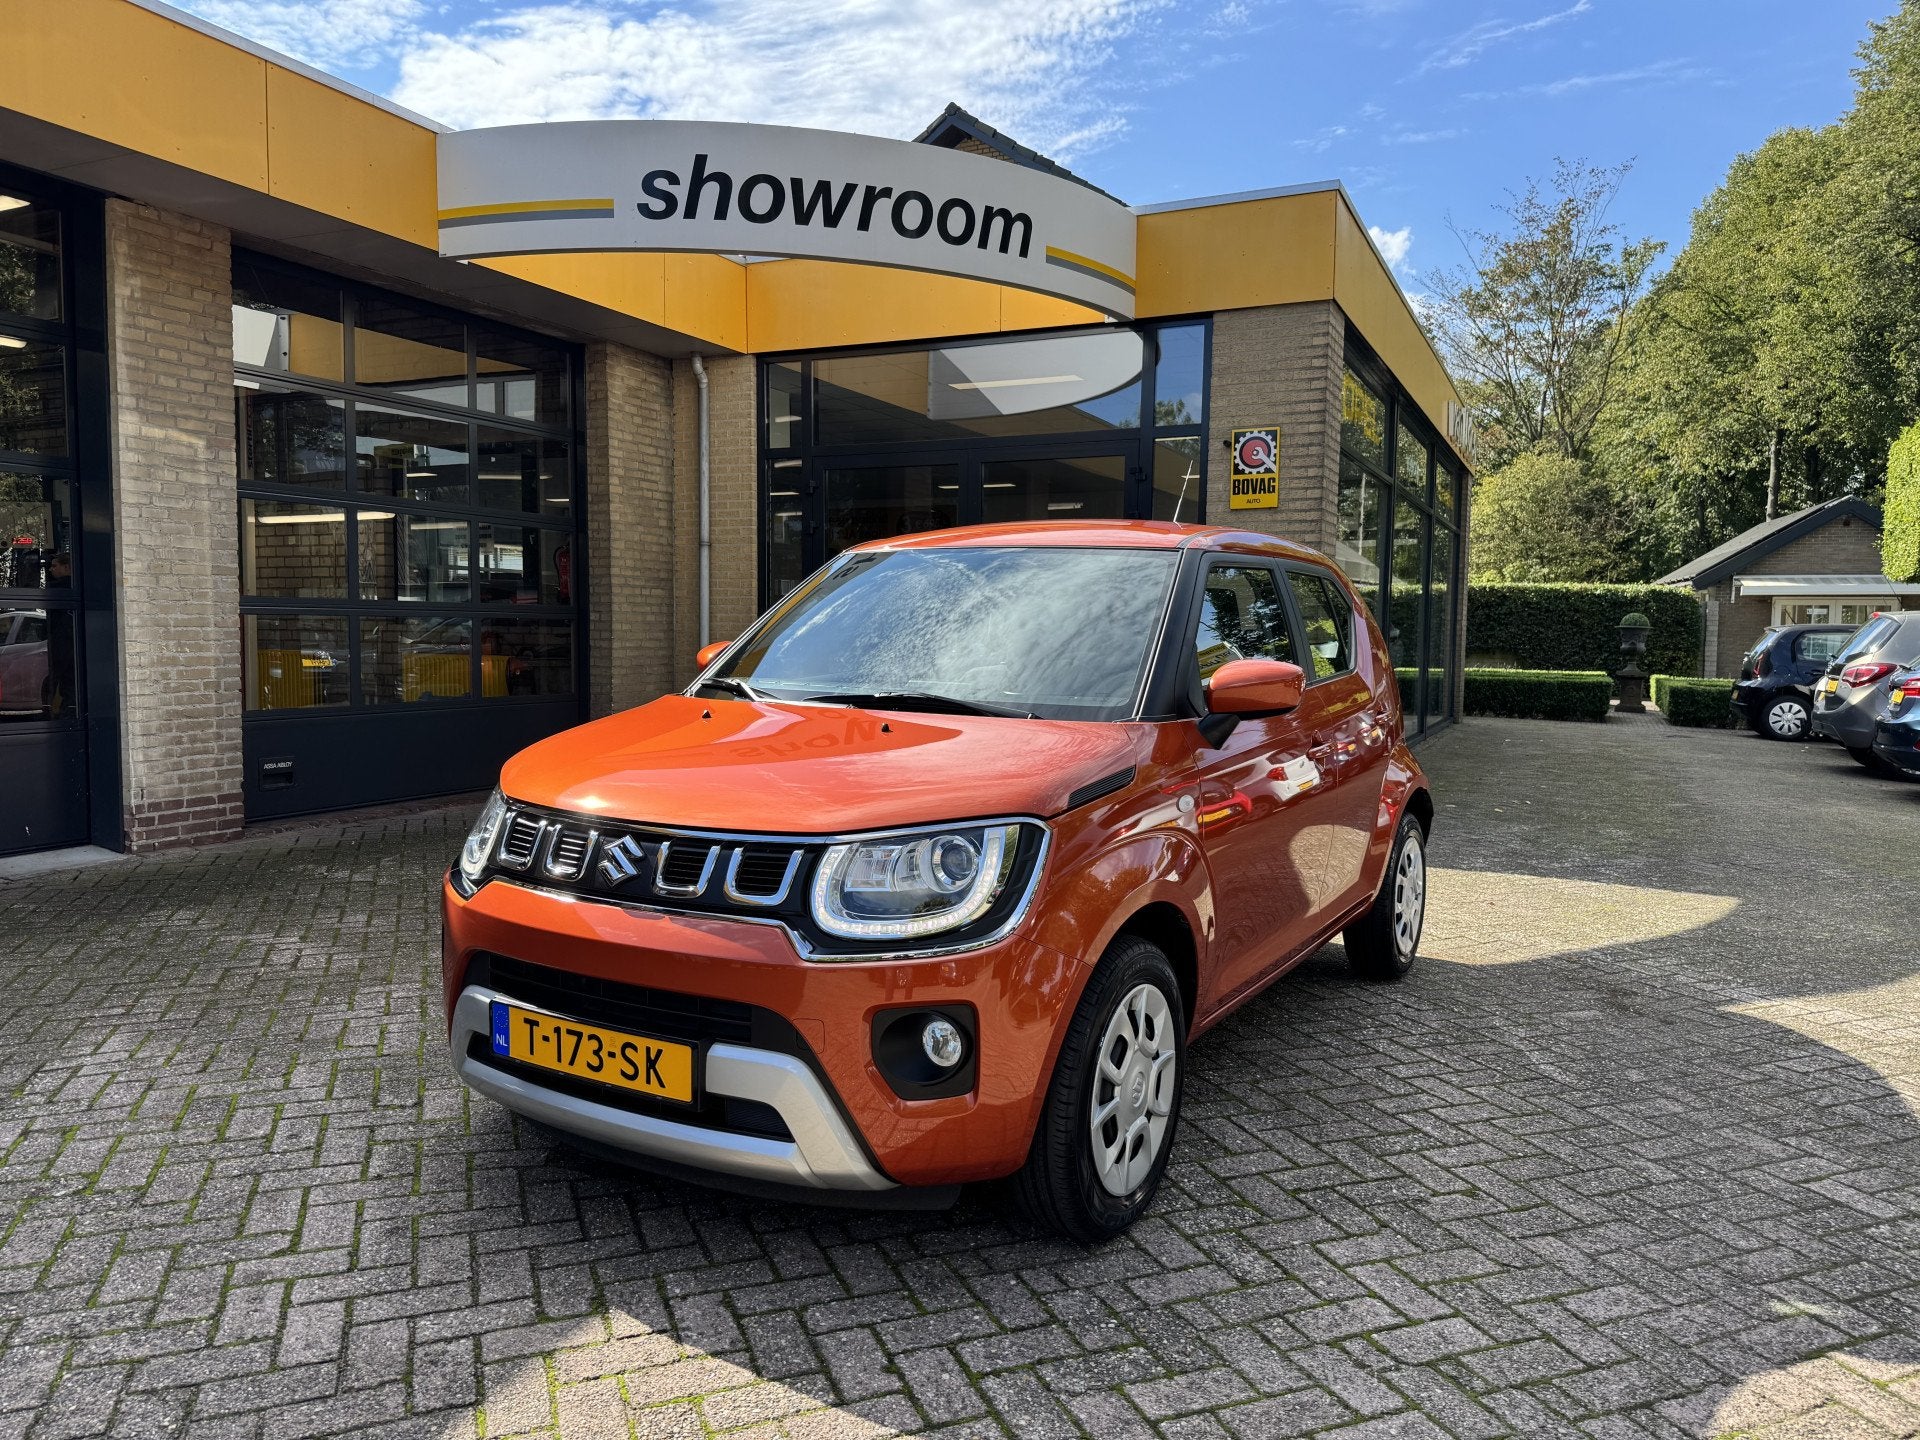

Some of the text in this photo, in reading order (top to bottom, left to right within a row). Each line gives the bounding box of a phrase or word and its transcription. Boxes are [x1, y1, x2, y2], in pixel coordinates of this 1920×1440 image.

[636, 153, 1034, 259] showroom
[1232, 477, 1276, 495] BOVAG
[496, 1034, 508, 1047] NL
[523, 1017, 666, 1089] T-173-SK
